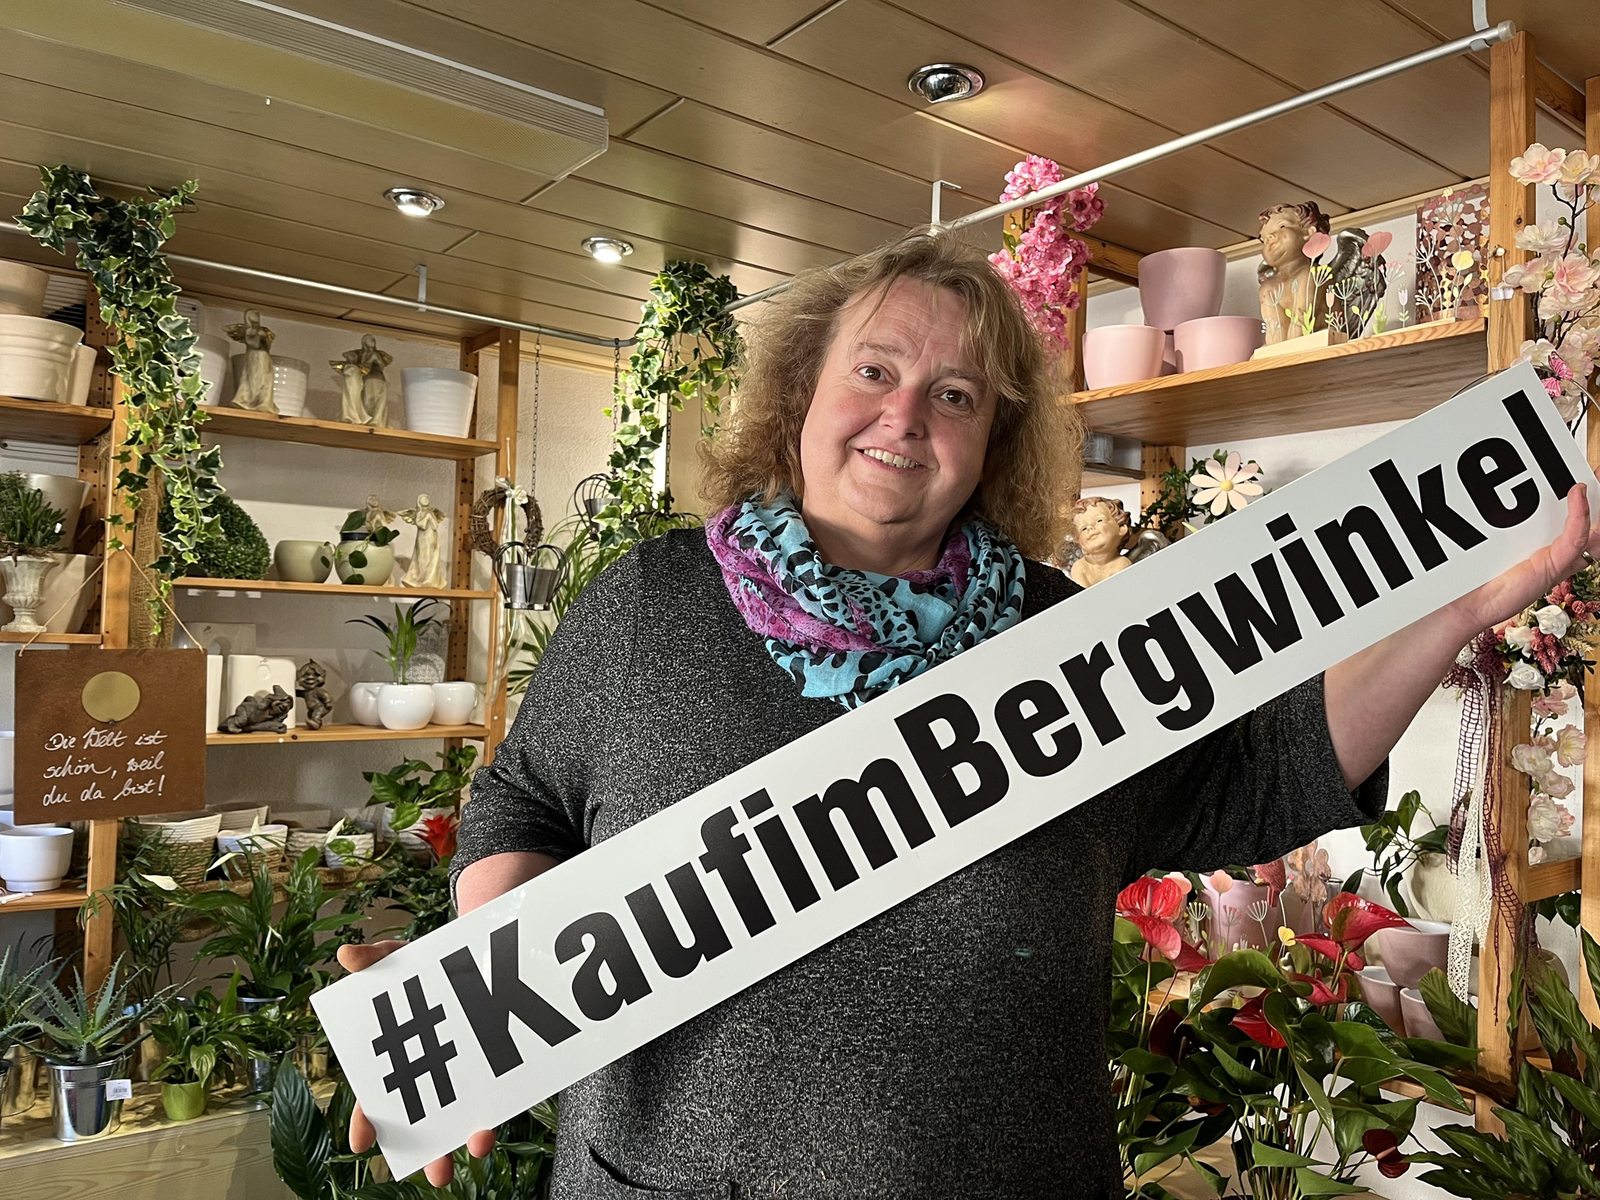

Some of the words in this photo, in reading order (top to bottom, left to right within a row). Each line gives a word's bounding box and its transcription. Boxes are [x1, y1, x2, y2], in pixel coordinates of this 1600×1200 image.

[44, 732, 77, 751] Die
[83, 727, 128, 750] Welt
[134, 730, 168, 746] ist
[43, 755, 117, 779] schön,
[126, 750, 165, 773] weil
[372, 389, 1577, 1125] #KaufimBergwinkel
[42, 785, 71, 807] du
[80, 782, 106, 802] da
[112, 774, 165, 801] bist!
